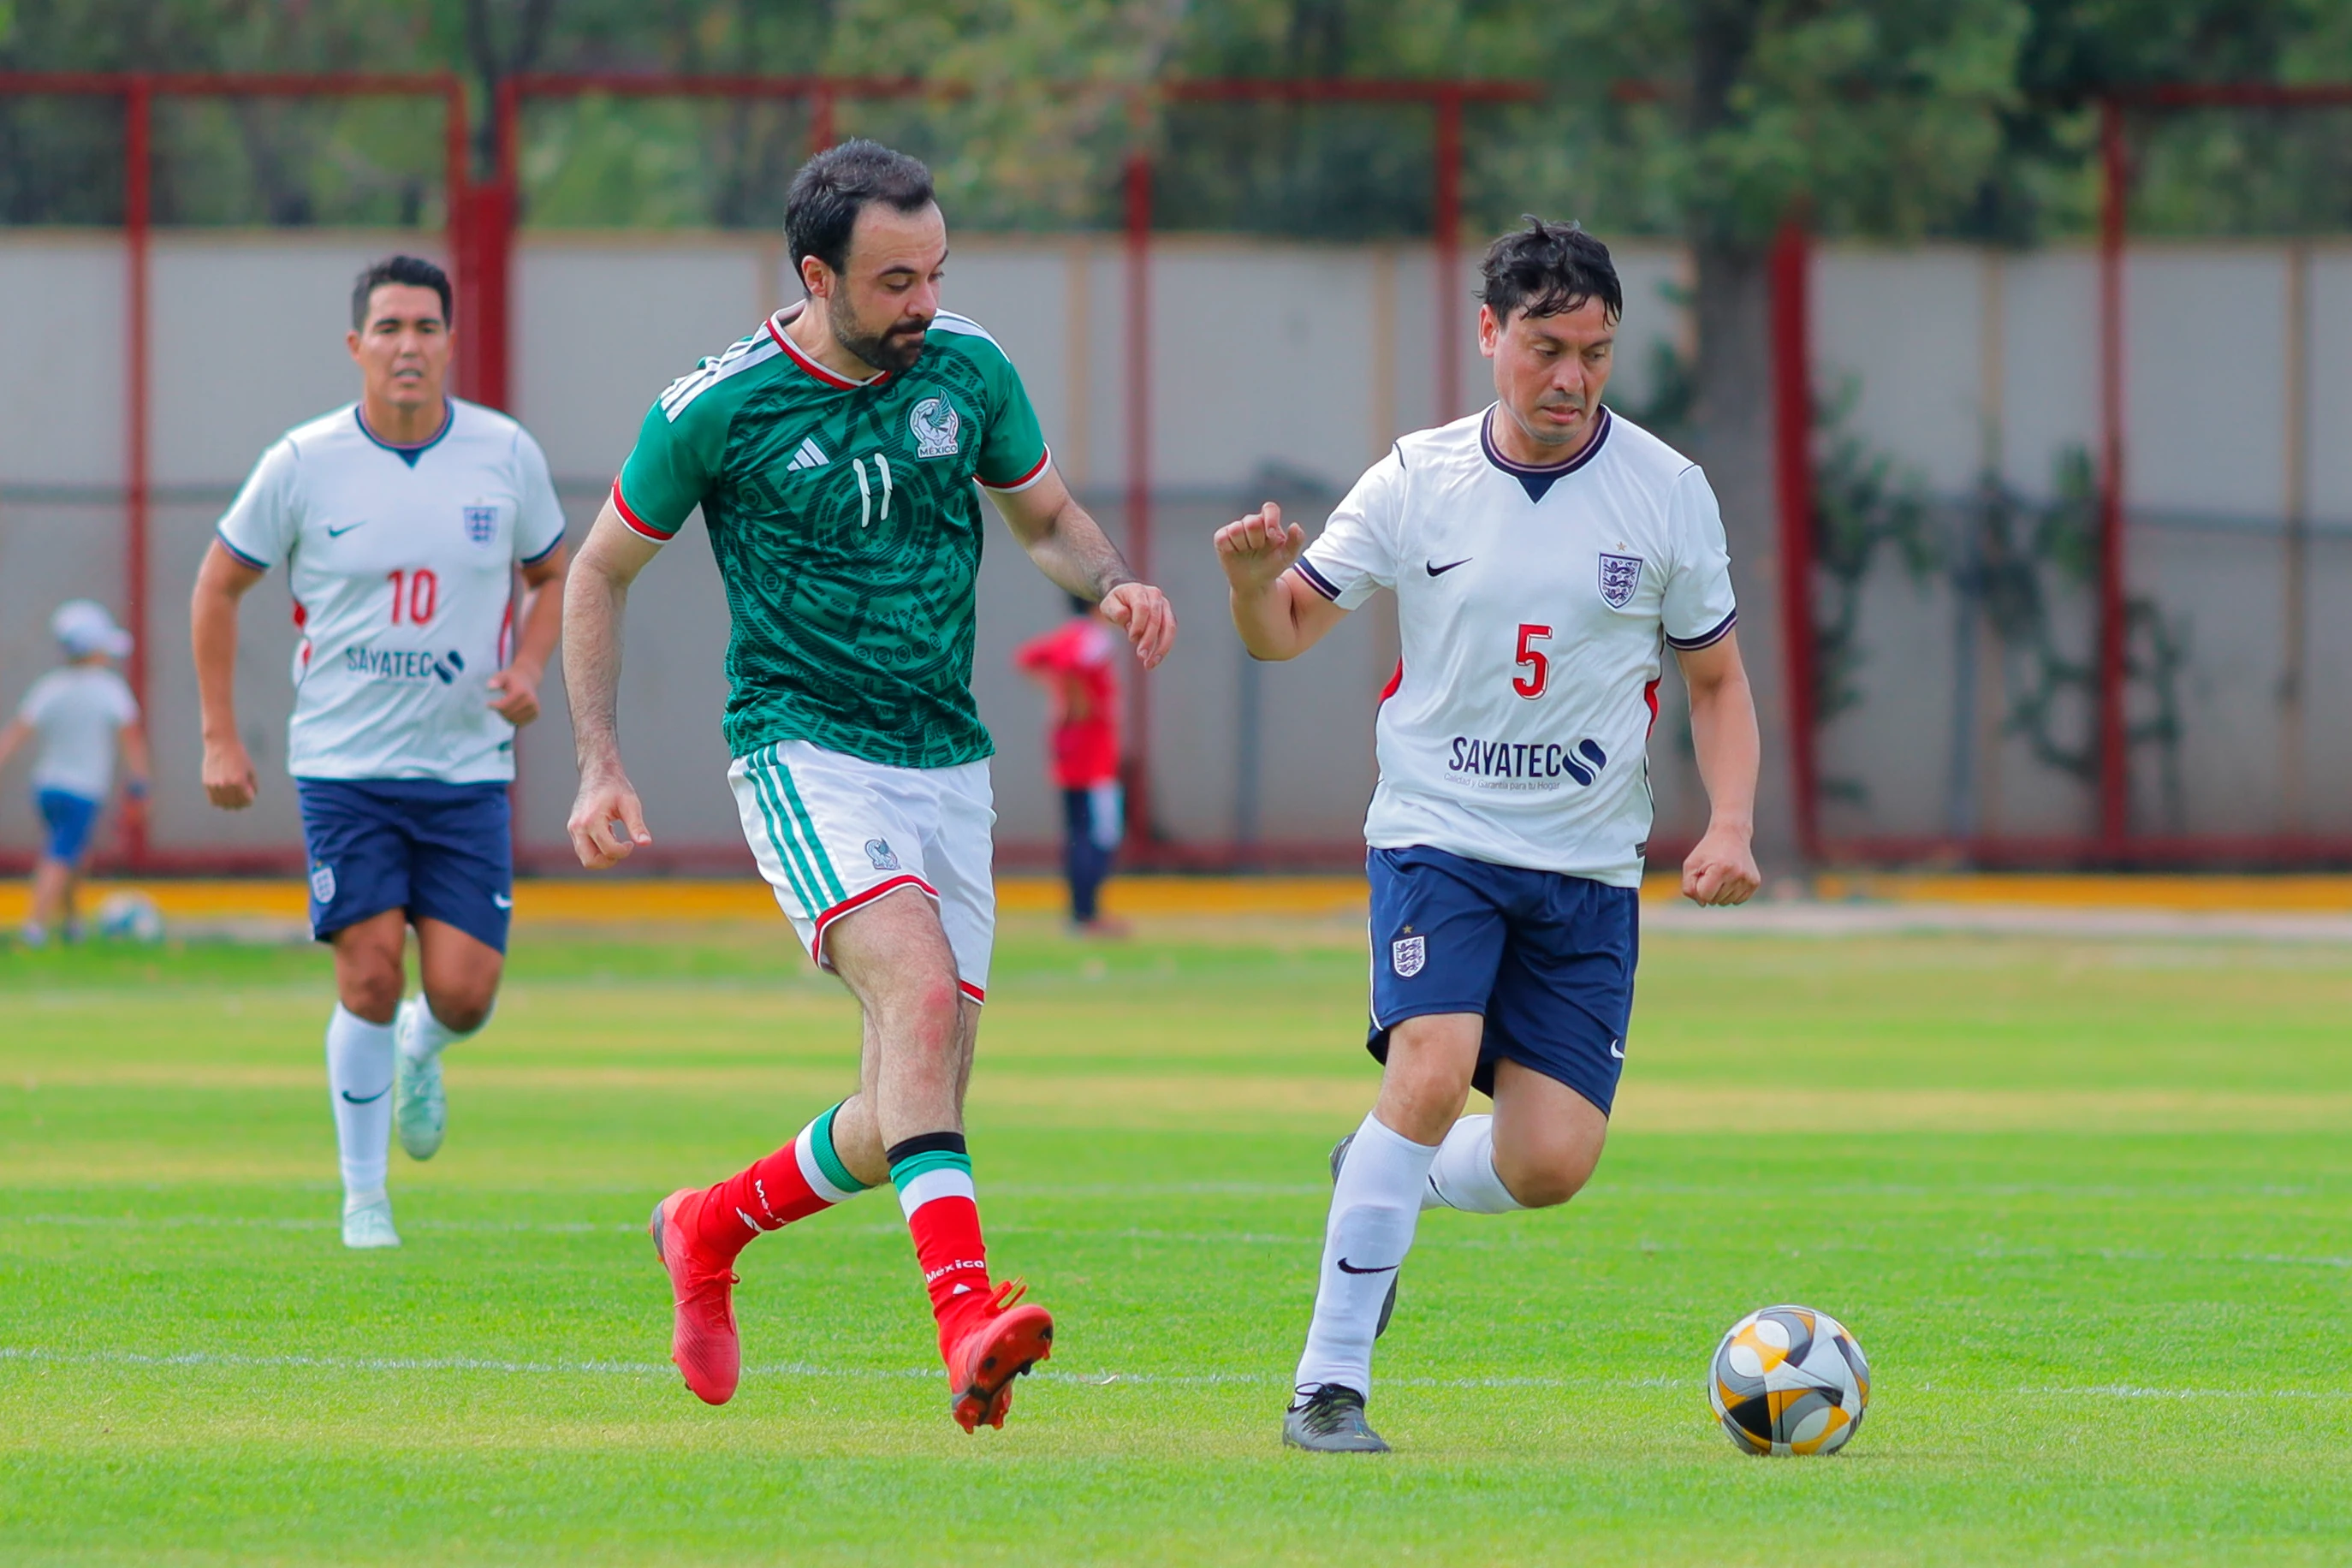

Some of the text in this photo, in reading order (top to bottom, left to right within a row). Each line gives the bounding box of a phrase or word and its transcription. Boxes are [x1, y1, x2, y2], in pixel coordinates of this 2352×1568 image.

[852, 452, 893, 528] 11
[386, 567, 438, 627] 10
[345, 645, 433, 678] SAYATEC
[1512, 622, 1553, 701] 5
[1448, 736, 1562, 778] SAYATEC
[1537, 781, 1561, 791] Hogar
